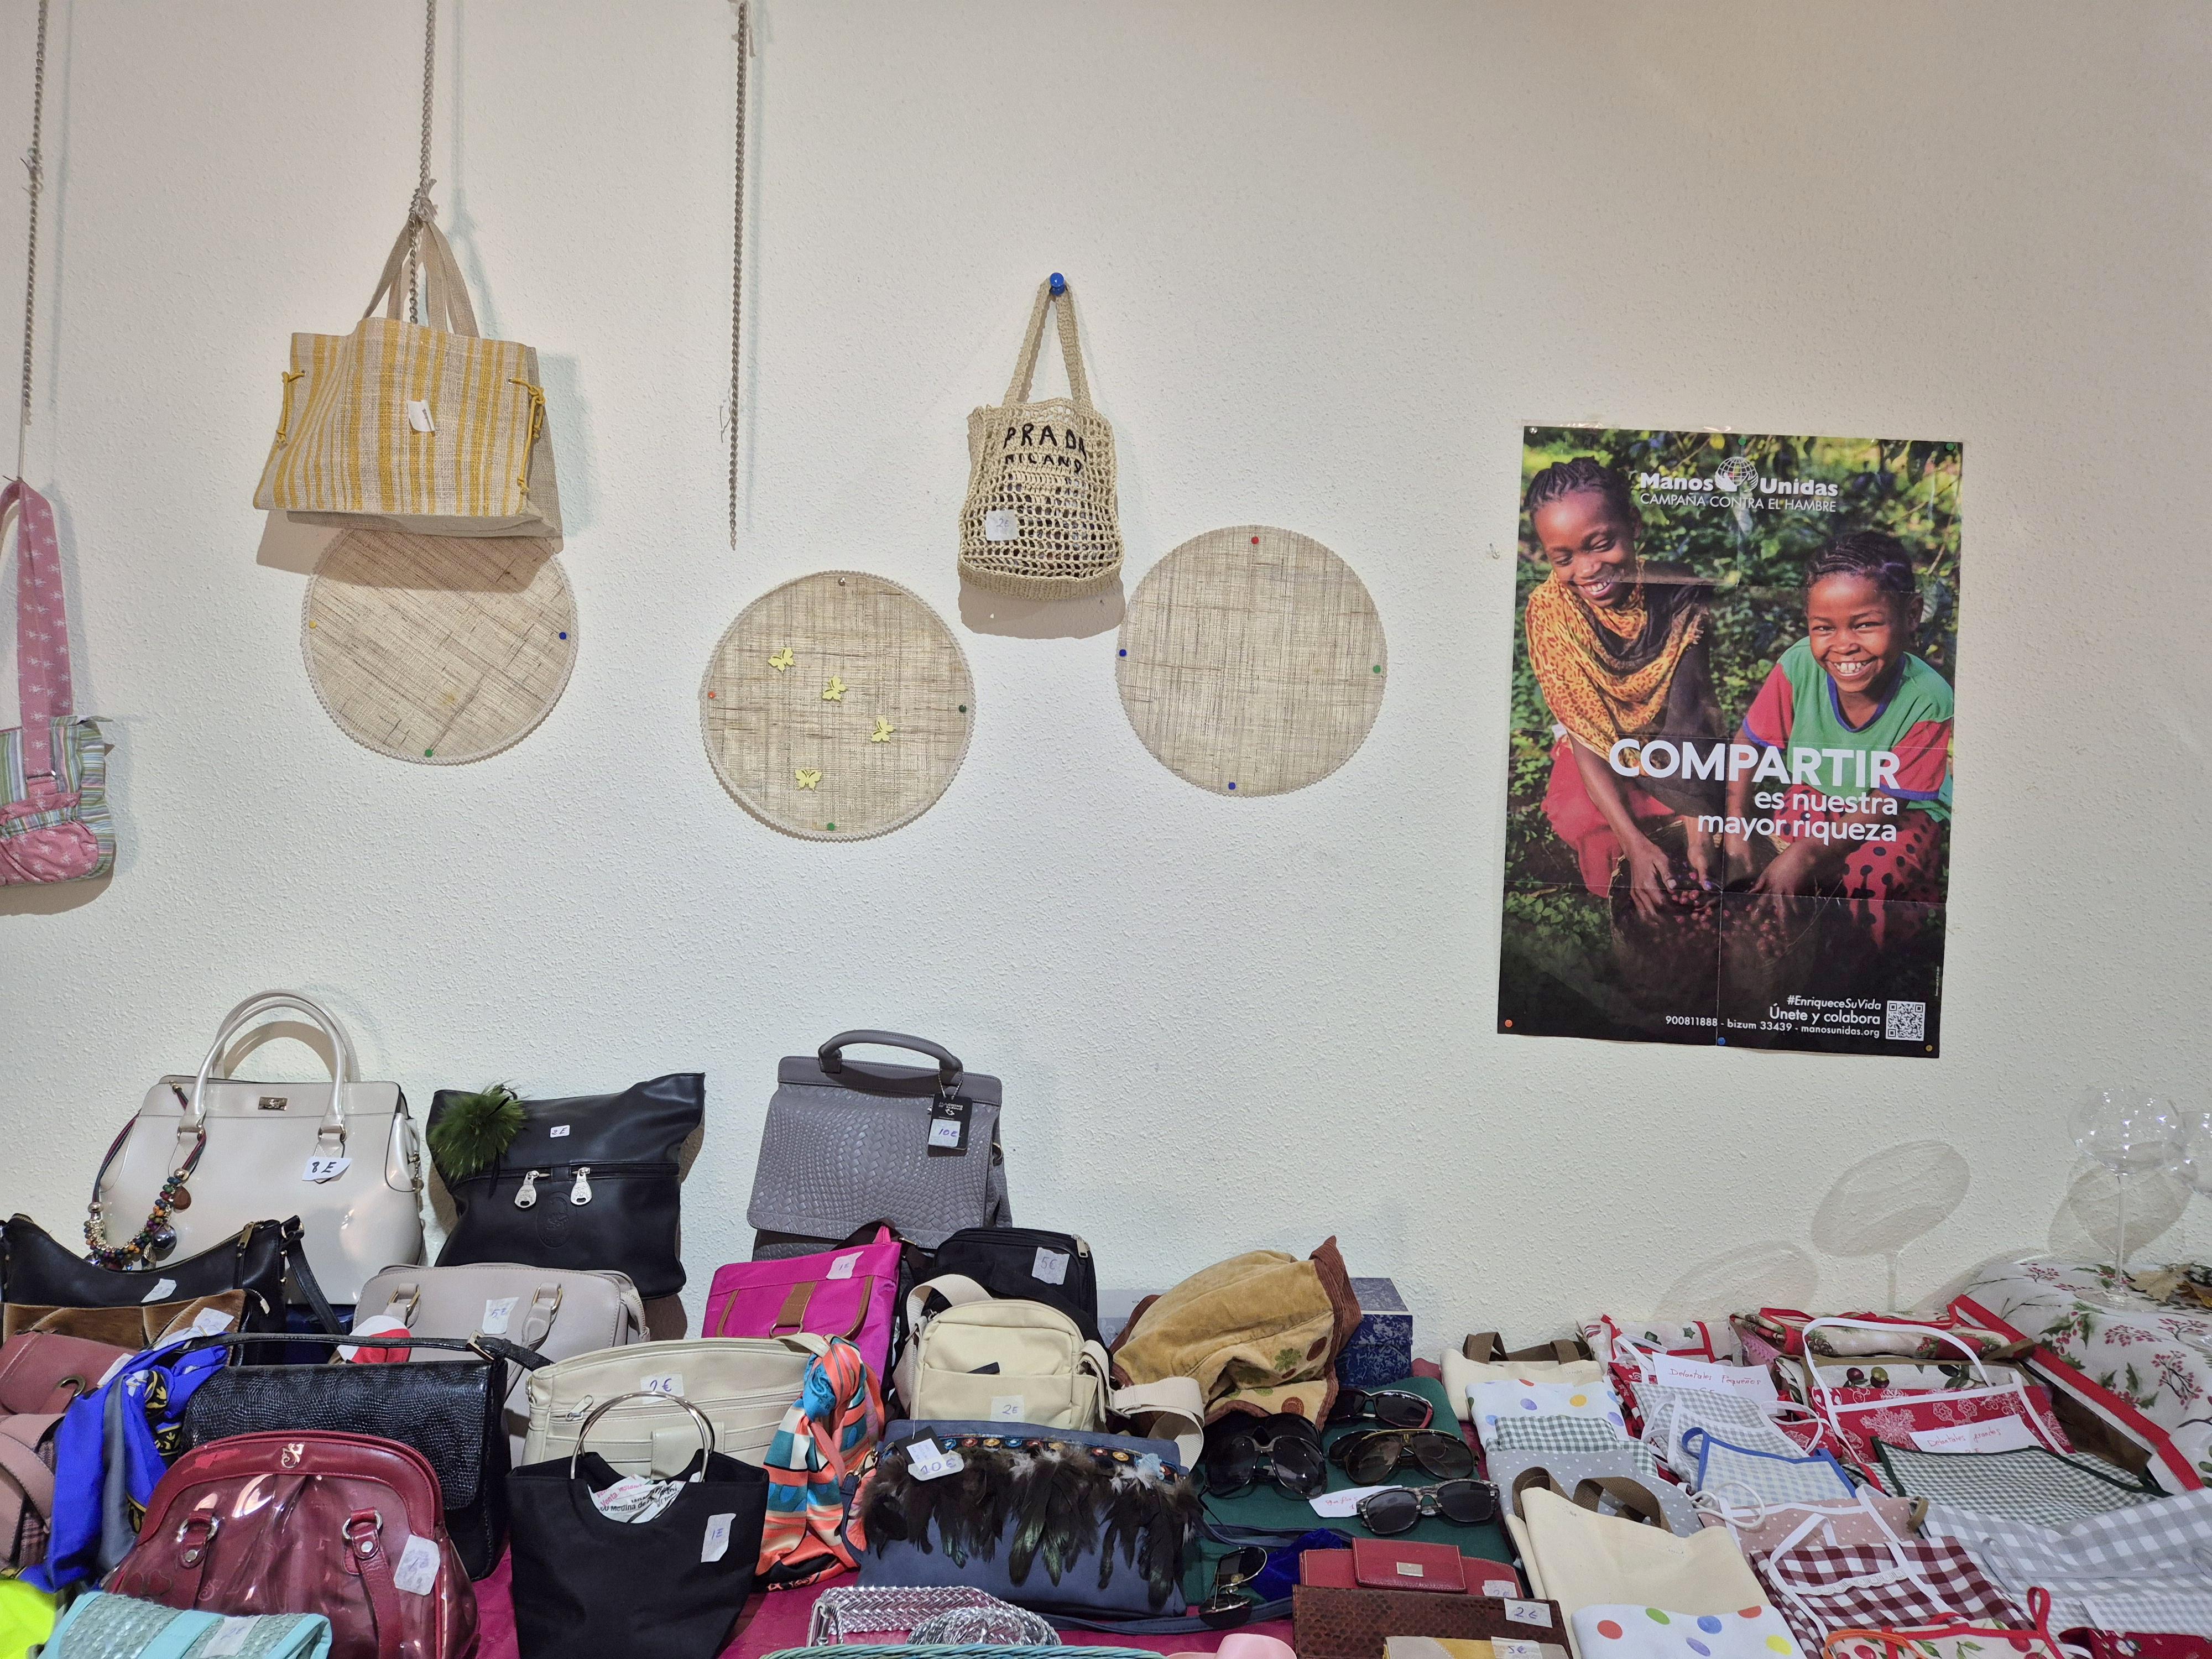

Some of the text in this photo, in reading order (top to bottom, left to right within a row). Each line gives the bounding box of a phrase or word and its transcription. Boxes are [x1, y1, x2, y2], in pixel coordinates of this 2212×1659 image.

[1640, 472, 1838, 497] Manos Unidas
[1640, 492, 1837, 513] CAMPAÑA CONTRA EL HAMBRE
[1608, 738, 1901, 790] COMPARTIR
[1754, 791, 1898, 816] es nuestra
[1698, 813, 1897, 846] mayor riqueza
[1769, 1003, 1881, 1025] Únete y colabora
[1787, 995, 1881, 1011] #EnriqueceSuVida
[1665, 1015, 1718, 1027] 900811888
[1727, 1018, 1756, 1030] bizum
[1760, 1021, 1792, 1032] 33439
[1801, 1025, 1880, 1039] manosunidas.org
[1668, 1368, 1761, 1387] Delantales Pequeños
[1927, 1432, 1966, 1447] Delantales
